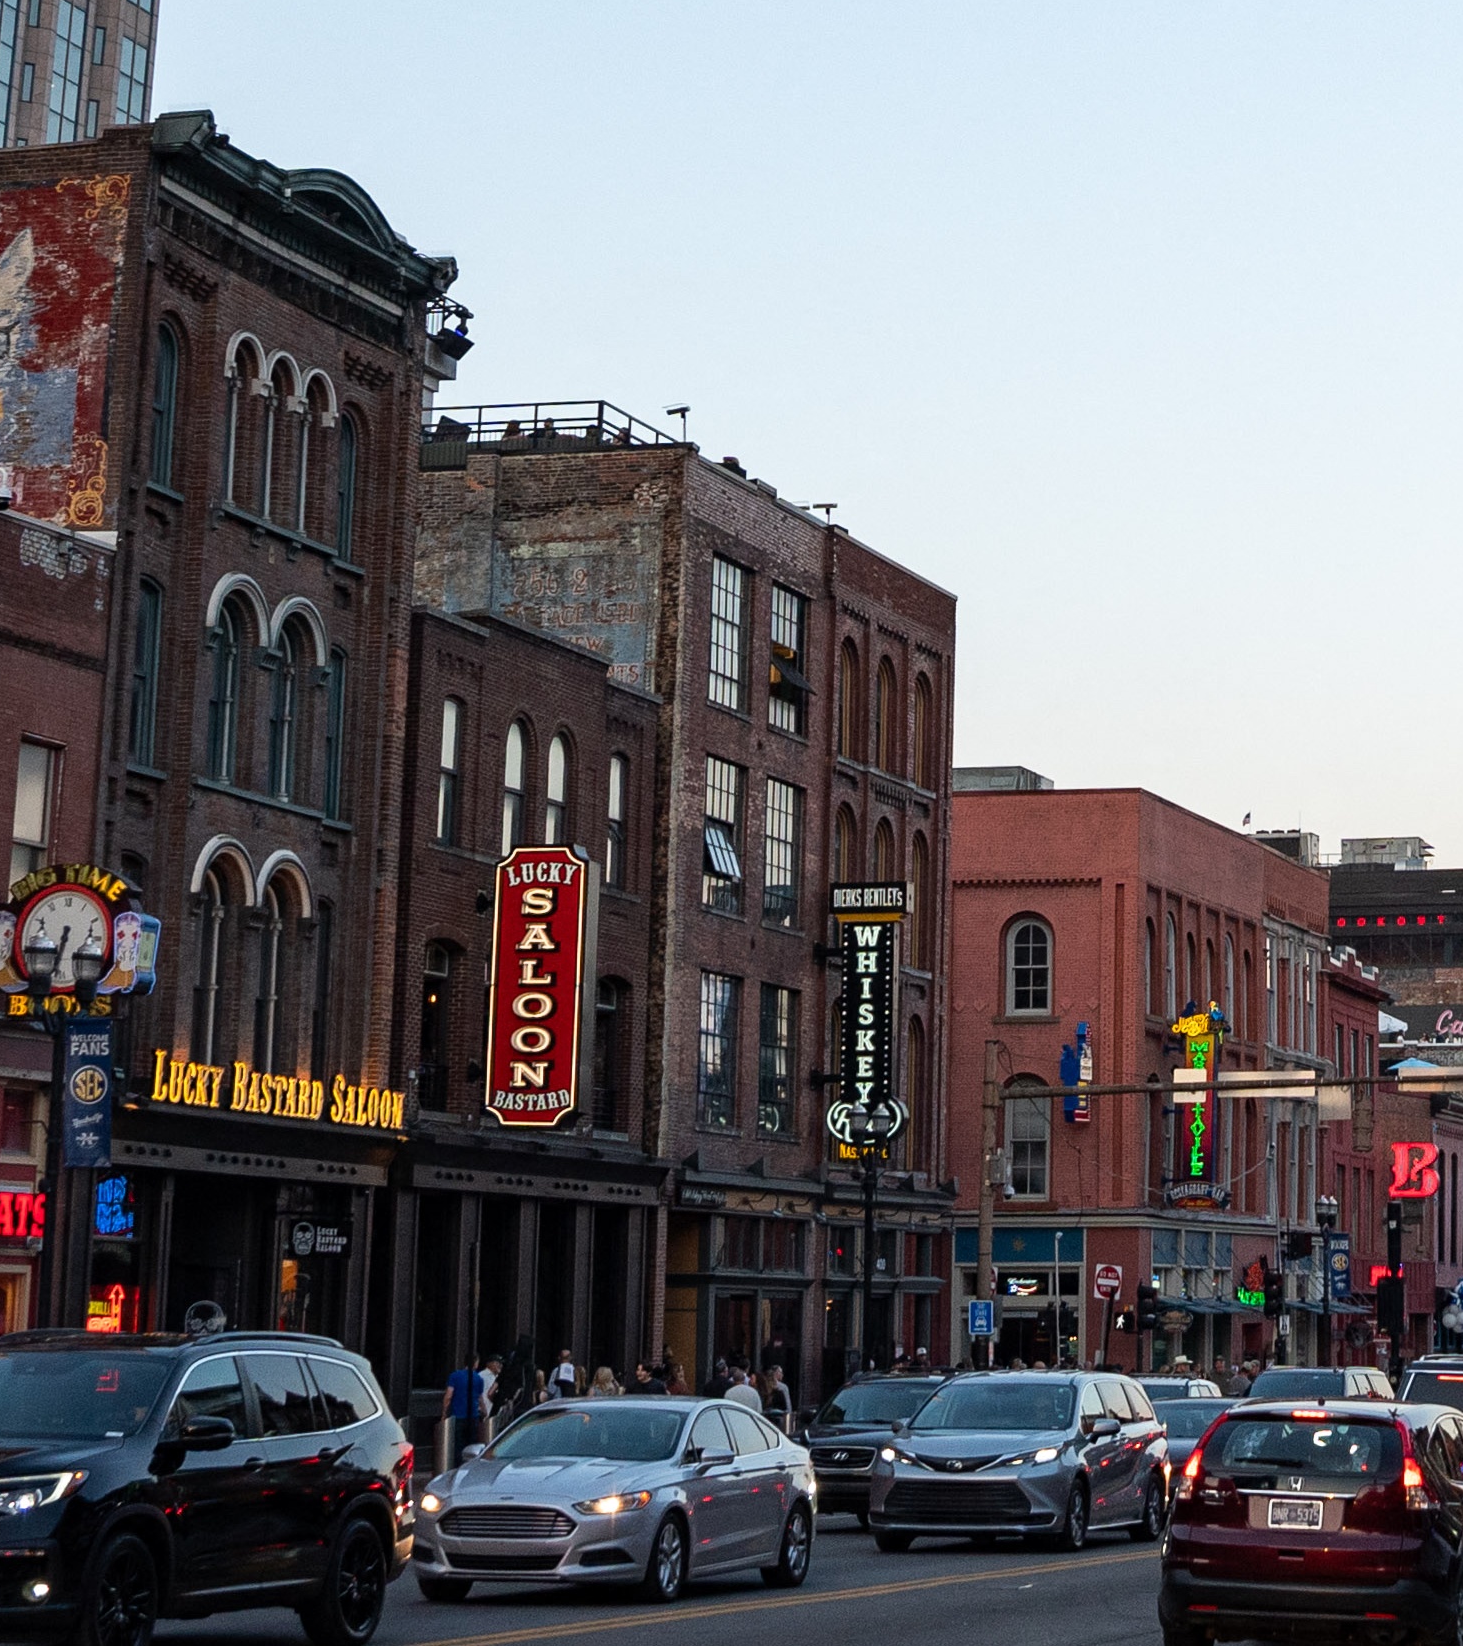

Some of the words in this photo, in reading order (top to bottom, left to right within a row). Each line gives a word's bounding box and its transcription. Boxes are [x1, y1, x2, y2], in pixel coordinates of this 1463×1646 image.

[63, 863, 129, 902] TIME
[505, 861, 579, 887] LUCKY
[833, 889, 862, 908] DIERKS
[1337, 915, 1447, 927] OOKOUT
[508, 887, 557, 1088] SALOON
[853, 925, 883, 1104] WHISKEY
[69, 1041, 110, 1056] FANS
[75, 1070, 104, 1098] SEC
[151, 1048, 225, 1109] LUCKY
[230, 1060, 324, 1121] BASTARD
[330, 1073, 406, 1130] SALOON
[493, 1089, 571, 1112] BASTARD
[1387, 1140, 1441, 1199] B
